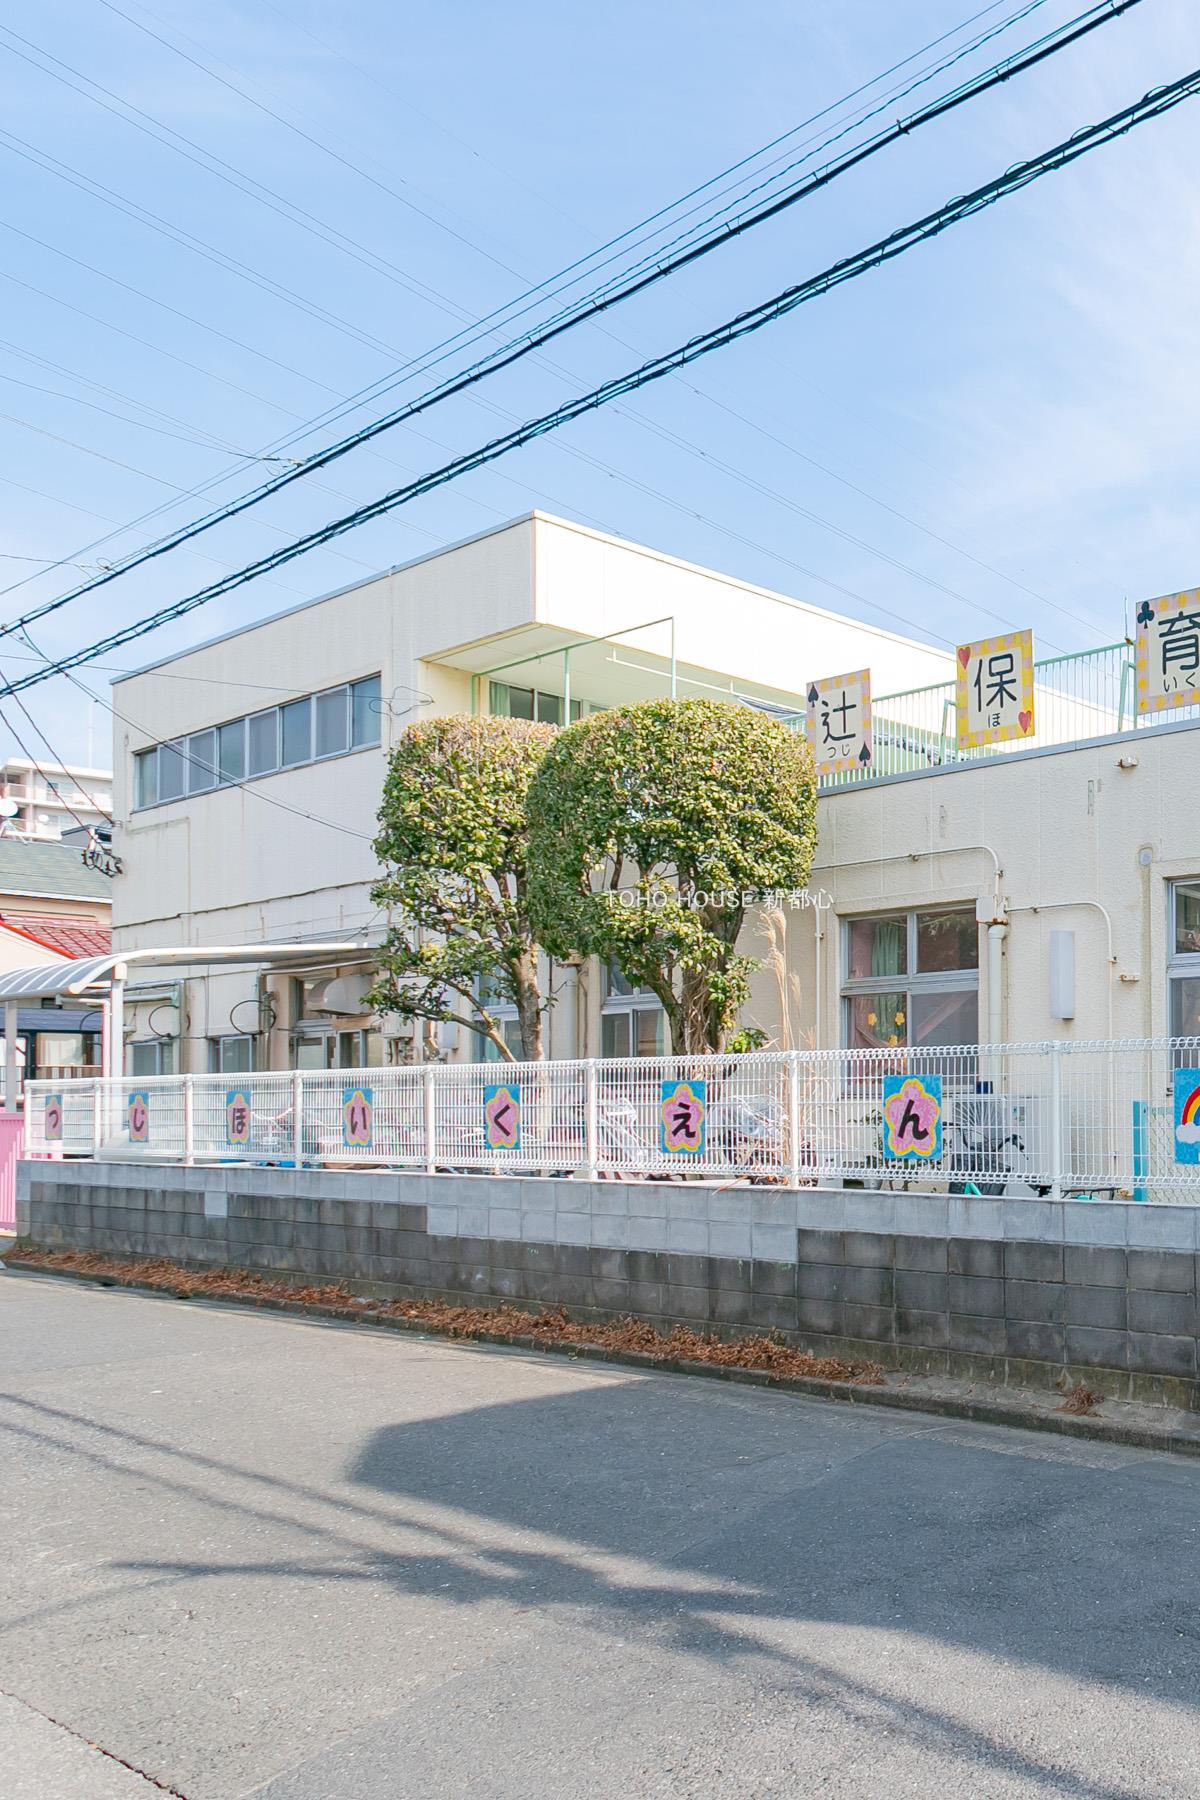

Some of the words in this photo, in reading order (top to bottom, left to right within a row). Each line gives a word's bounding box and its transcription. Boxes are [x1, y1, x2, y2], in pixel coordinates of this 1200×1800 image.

[973, 652, 1018, 713] 保
[1162, 671, 1196, 692] いく
[820, 690, 857, 745] 辻
[987, 712, 1001, 729] ほ
[826, 744, 851, 759] つじ
[48, 1109, 60, 1129] つ
[133, 1109, 145, 1132] じ
[232, 1107, 247, 1134] ほ
[350, 1106, 367, 1134] い
[493, 1103, 511, 1137] く
[671, 1102, 697, 1139] え
[897, 1099, 929, 1141] ん
